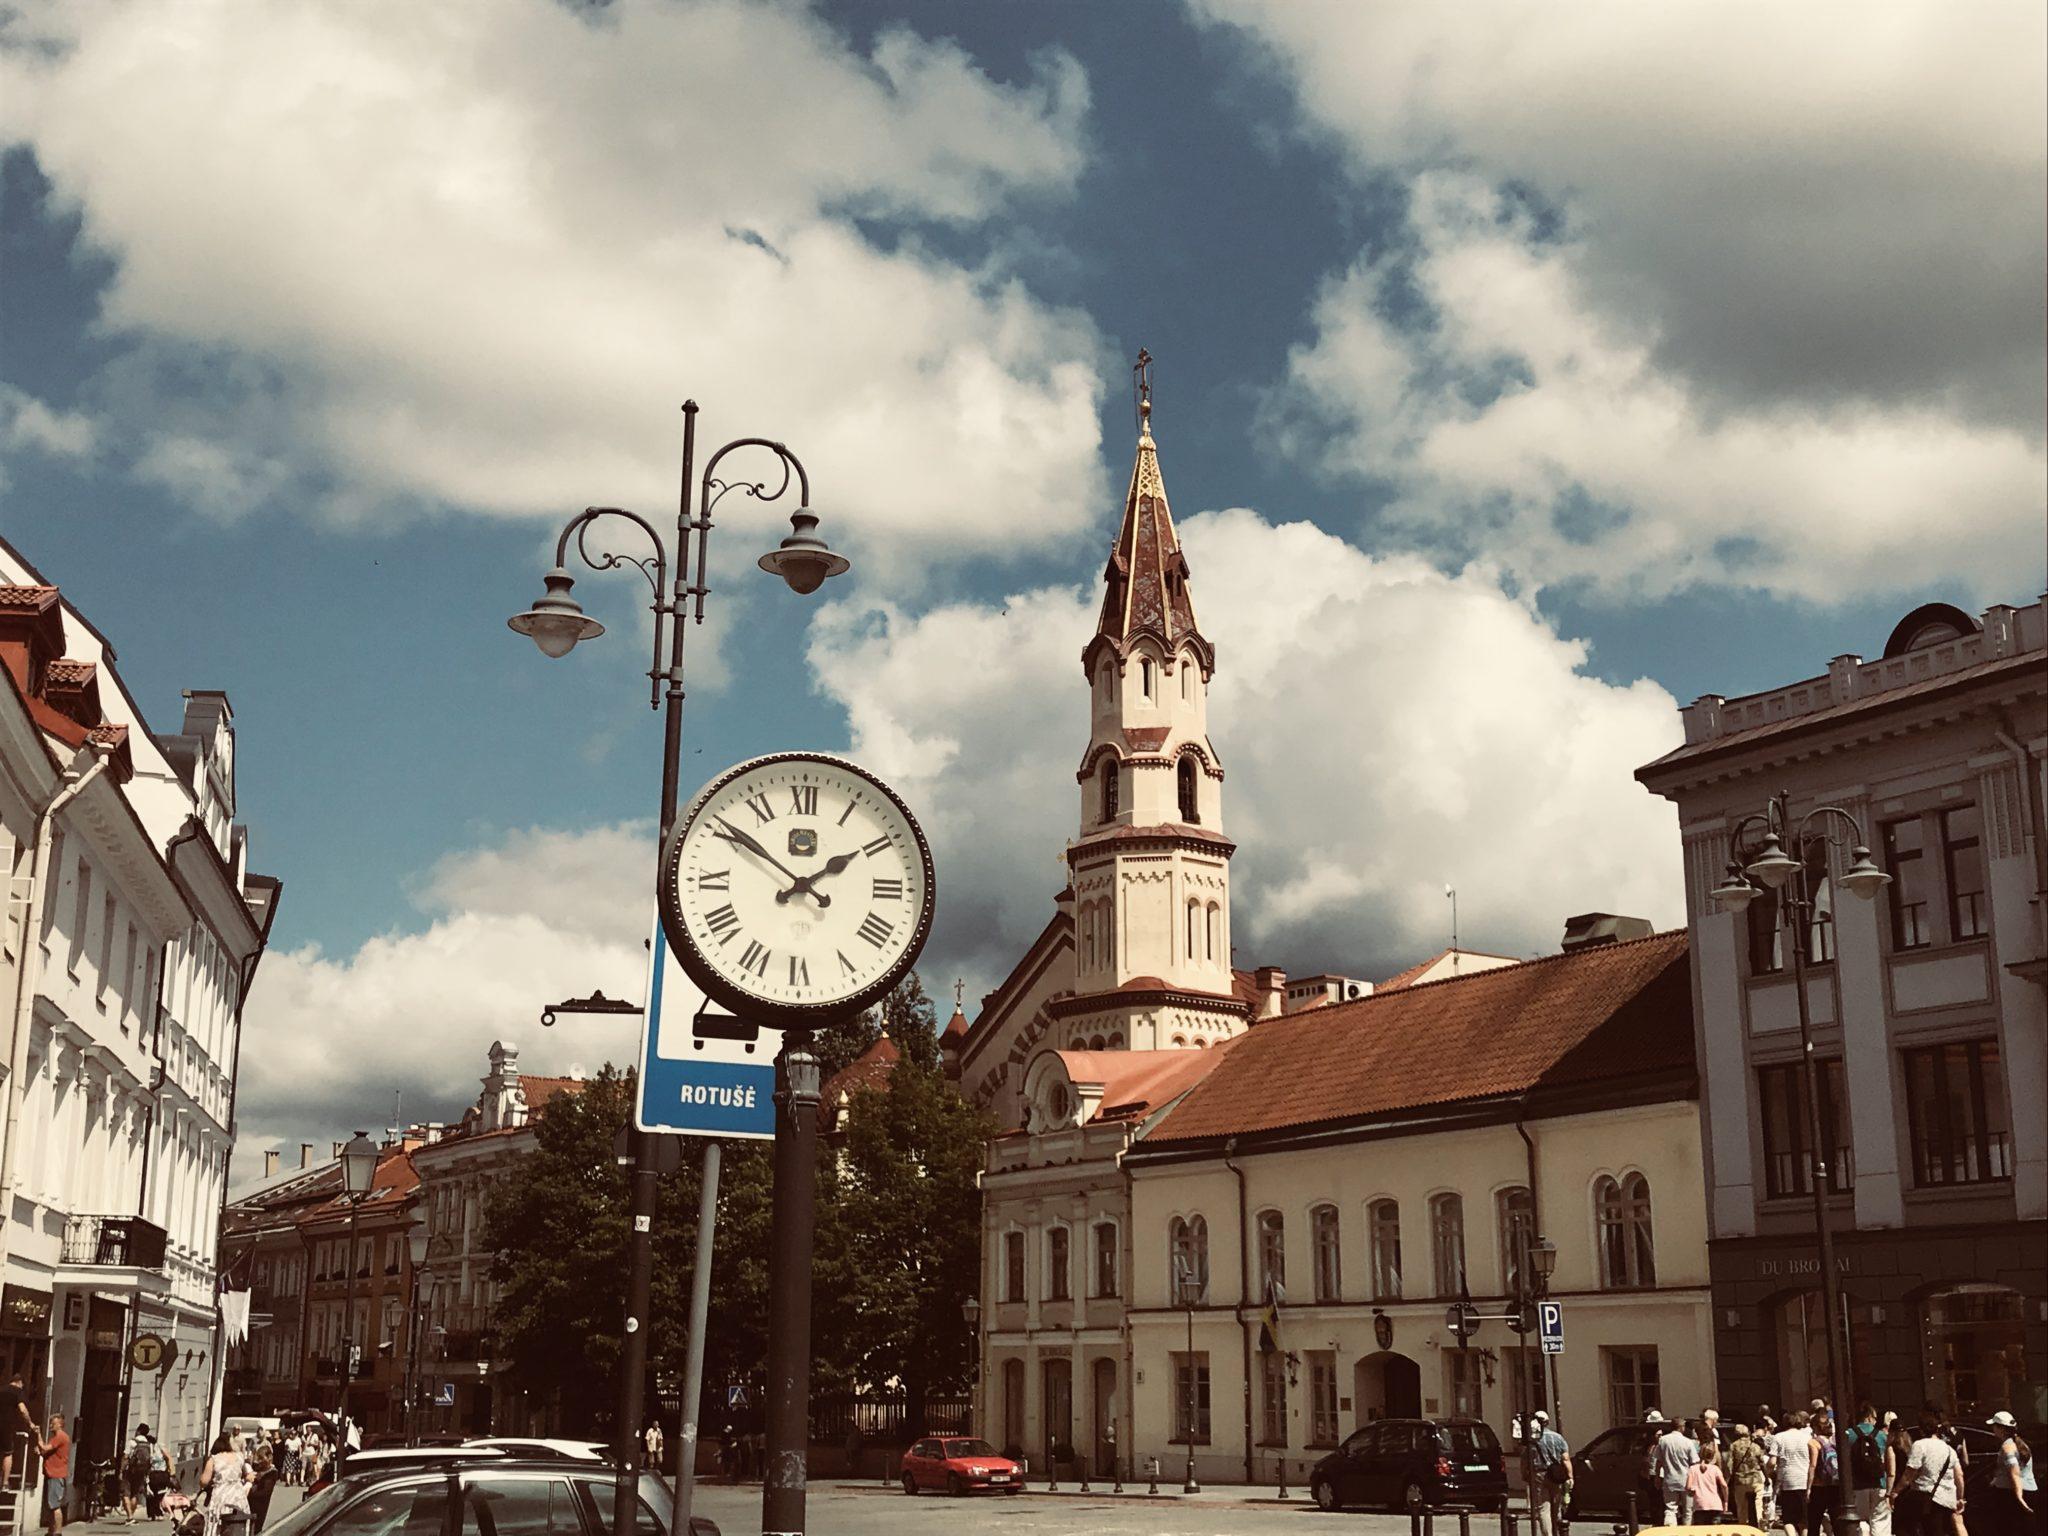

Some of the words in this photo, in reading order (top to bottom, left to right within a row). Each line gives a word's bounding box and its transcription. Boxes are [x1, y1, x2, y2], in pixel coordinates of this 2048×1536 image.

[745, 792, 777, 828] XI
[788, 785, 819, 816] XII
[836, 800, 858, 827] I
[861, 832, 893, 857] II
[699, 868, 730, 892] IX
[872, 877, 903, 901] III
[704, 901, 743, 947] VIII
[856, 911, 896, 950] IIII
[737, 938, 772, 979] VII
[787, 955, 811, 986] VI
[836, 949, 858, 977] V
[680, 1084, 757, 1108] ROTUŠĖ
[1761, 1260, 1782, 1275] DU
[1789, 1257, 1850, 1274] BROAI
[1544, 1305, 1559, 1334] P
[140, 1345, 156, 1364] T
